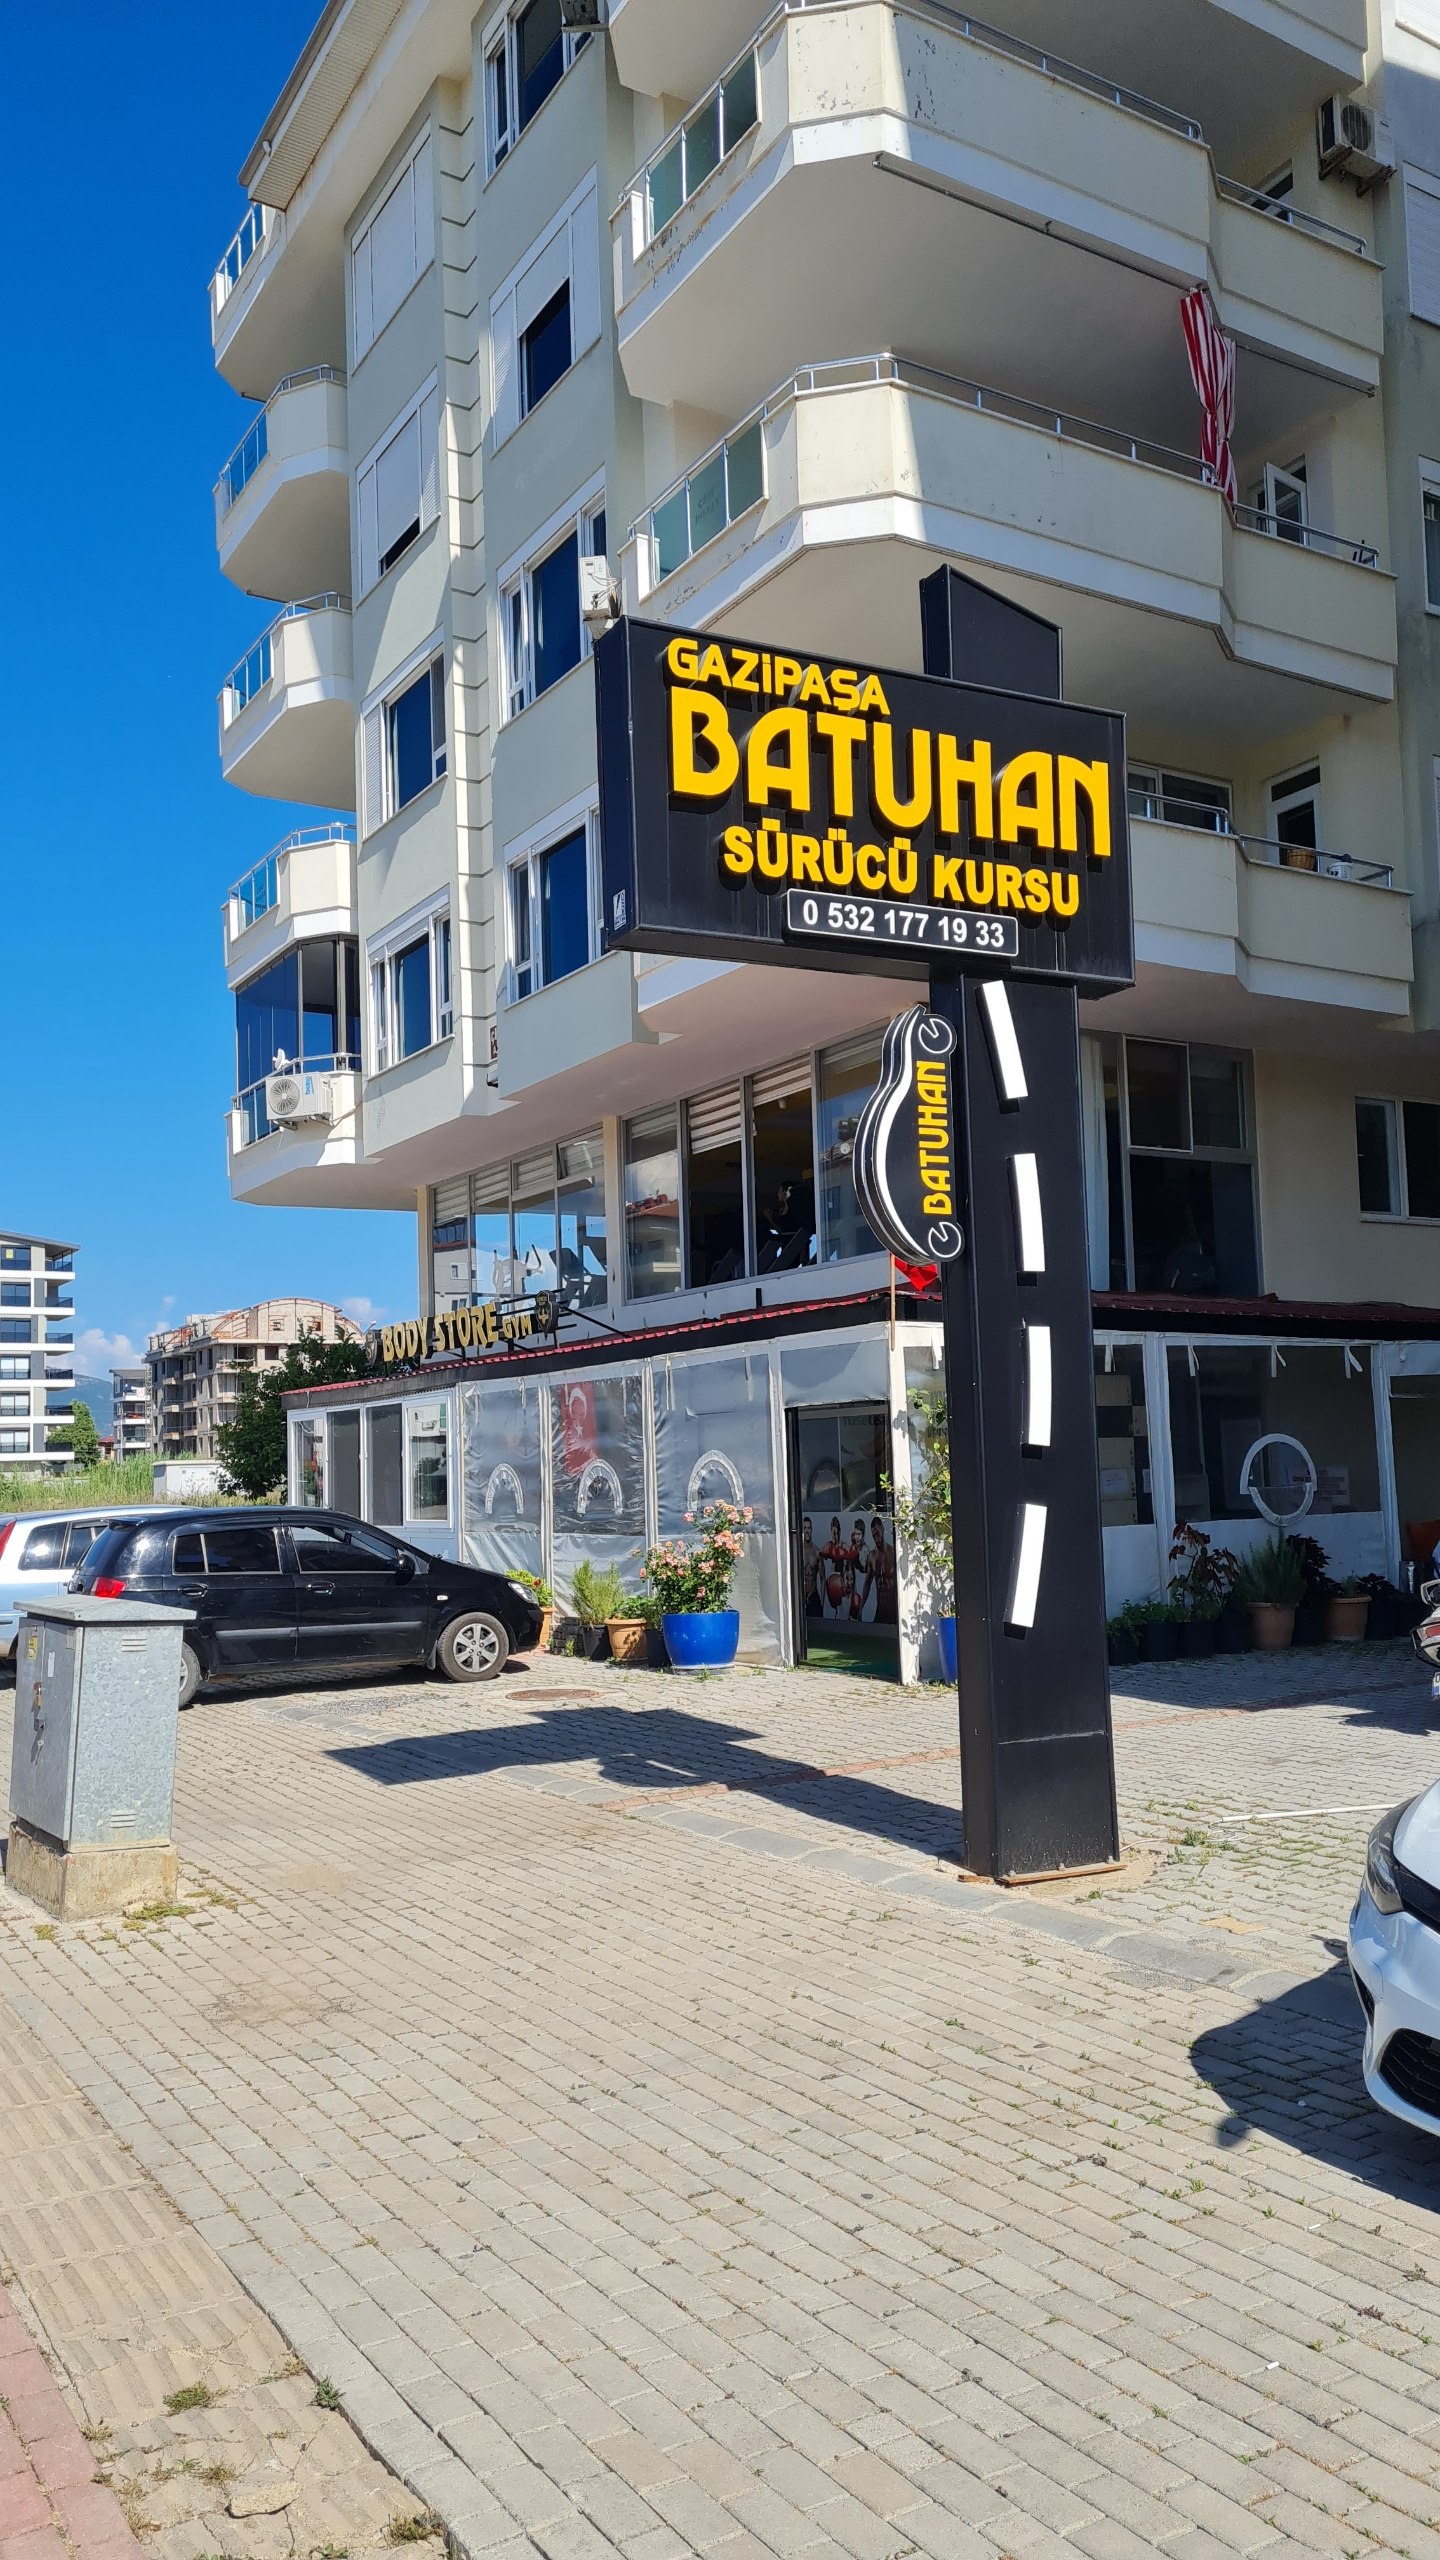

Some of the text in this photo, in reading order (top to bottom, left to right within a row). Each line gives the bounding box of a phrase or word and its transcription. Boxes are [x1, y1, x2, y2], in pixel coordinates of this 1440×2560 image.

[671, 685, 1111, 857] BATUHAN
[723, 817, 1080, 916] SÜRÜCÜ KURSU
[802, 899, 1005, 948] 0 532 177 19 33
[916, 1060, 953, 1215] BATUHAN
[381, 1302, 533, 1362] BODY STORE GYM
